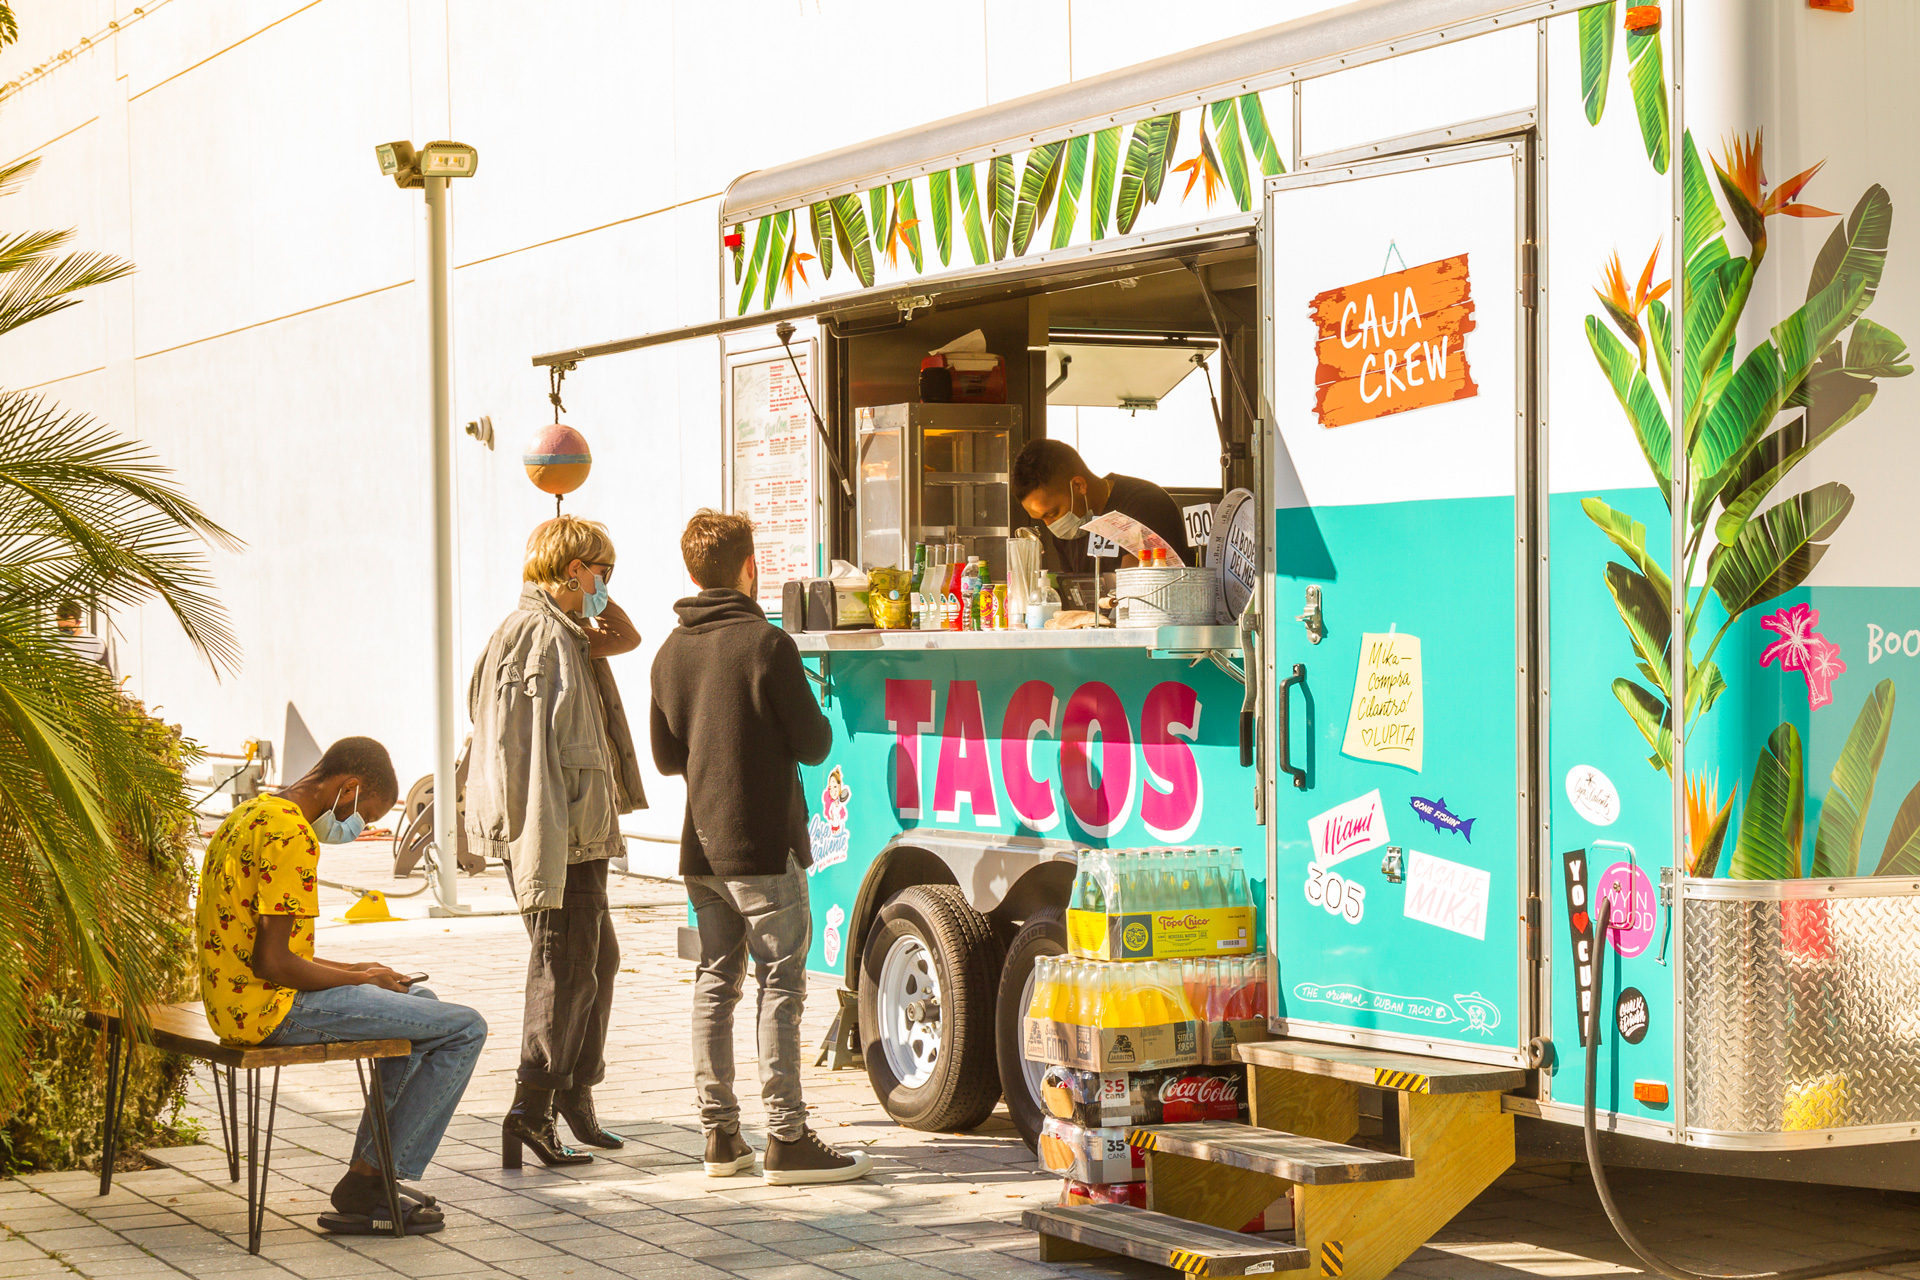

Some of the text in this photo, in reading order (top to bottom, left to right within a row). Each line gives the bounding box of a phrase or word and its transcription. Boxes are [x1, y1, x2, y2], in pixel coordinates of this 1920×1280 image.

[1340, 286, 1422, 350] CAJA
[1359, 335, 1449, 404] CREW
[1185, 510, 1212, 539] 100
[1374, 723, 1416, 748] LUPITA
[885, 678, 1202, 843] TACOS
[1413, 800, 1434, 815] GONE
[1321, 803, 1376, 859] Miami
[1413, 858, 1485, 898] CASA DE
[1568, 859, 1585, 906] YO
[1307, 867, 1363, 919] 305
[1603, 887, 1647, 911] WYN
[1409, 882, 1481, 933] MIKA
[1597, 907, 1654, 932] OOD
[1302, 986, 1434, 1017] THE original CUBAN TACO!
[1110, 1053, 1134, 1061] JARRITOS
[1178, 1041, 1195, 1052] 1950
[1104, 1078, 1125, 1093] 35
[1105, 1091, 1126, 1100] cans
[1158, 1074, 1242, 1105] Coca-Cola
[1106, 1139, 1126, 1151] 35
[1107, 1152, 1127, 1160] CANS
[372, 1219, 393, 1230] PUM
